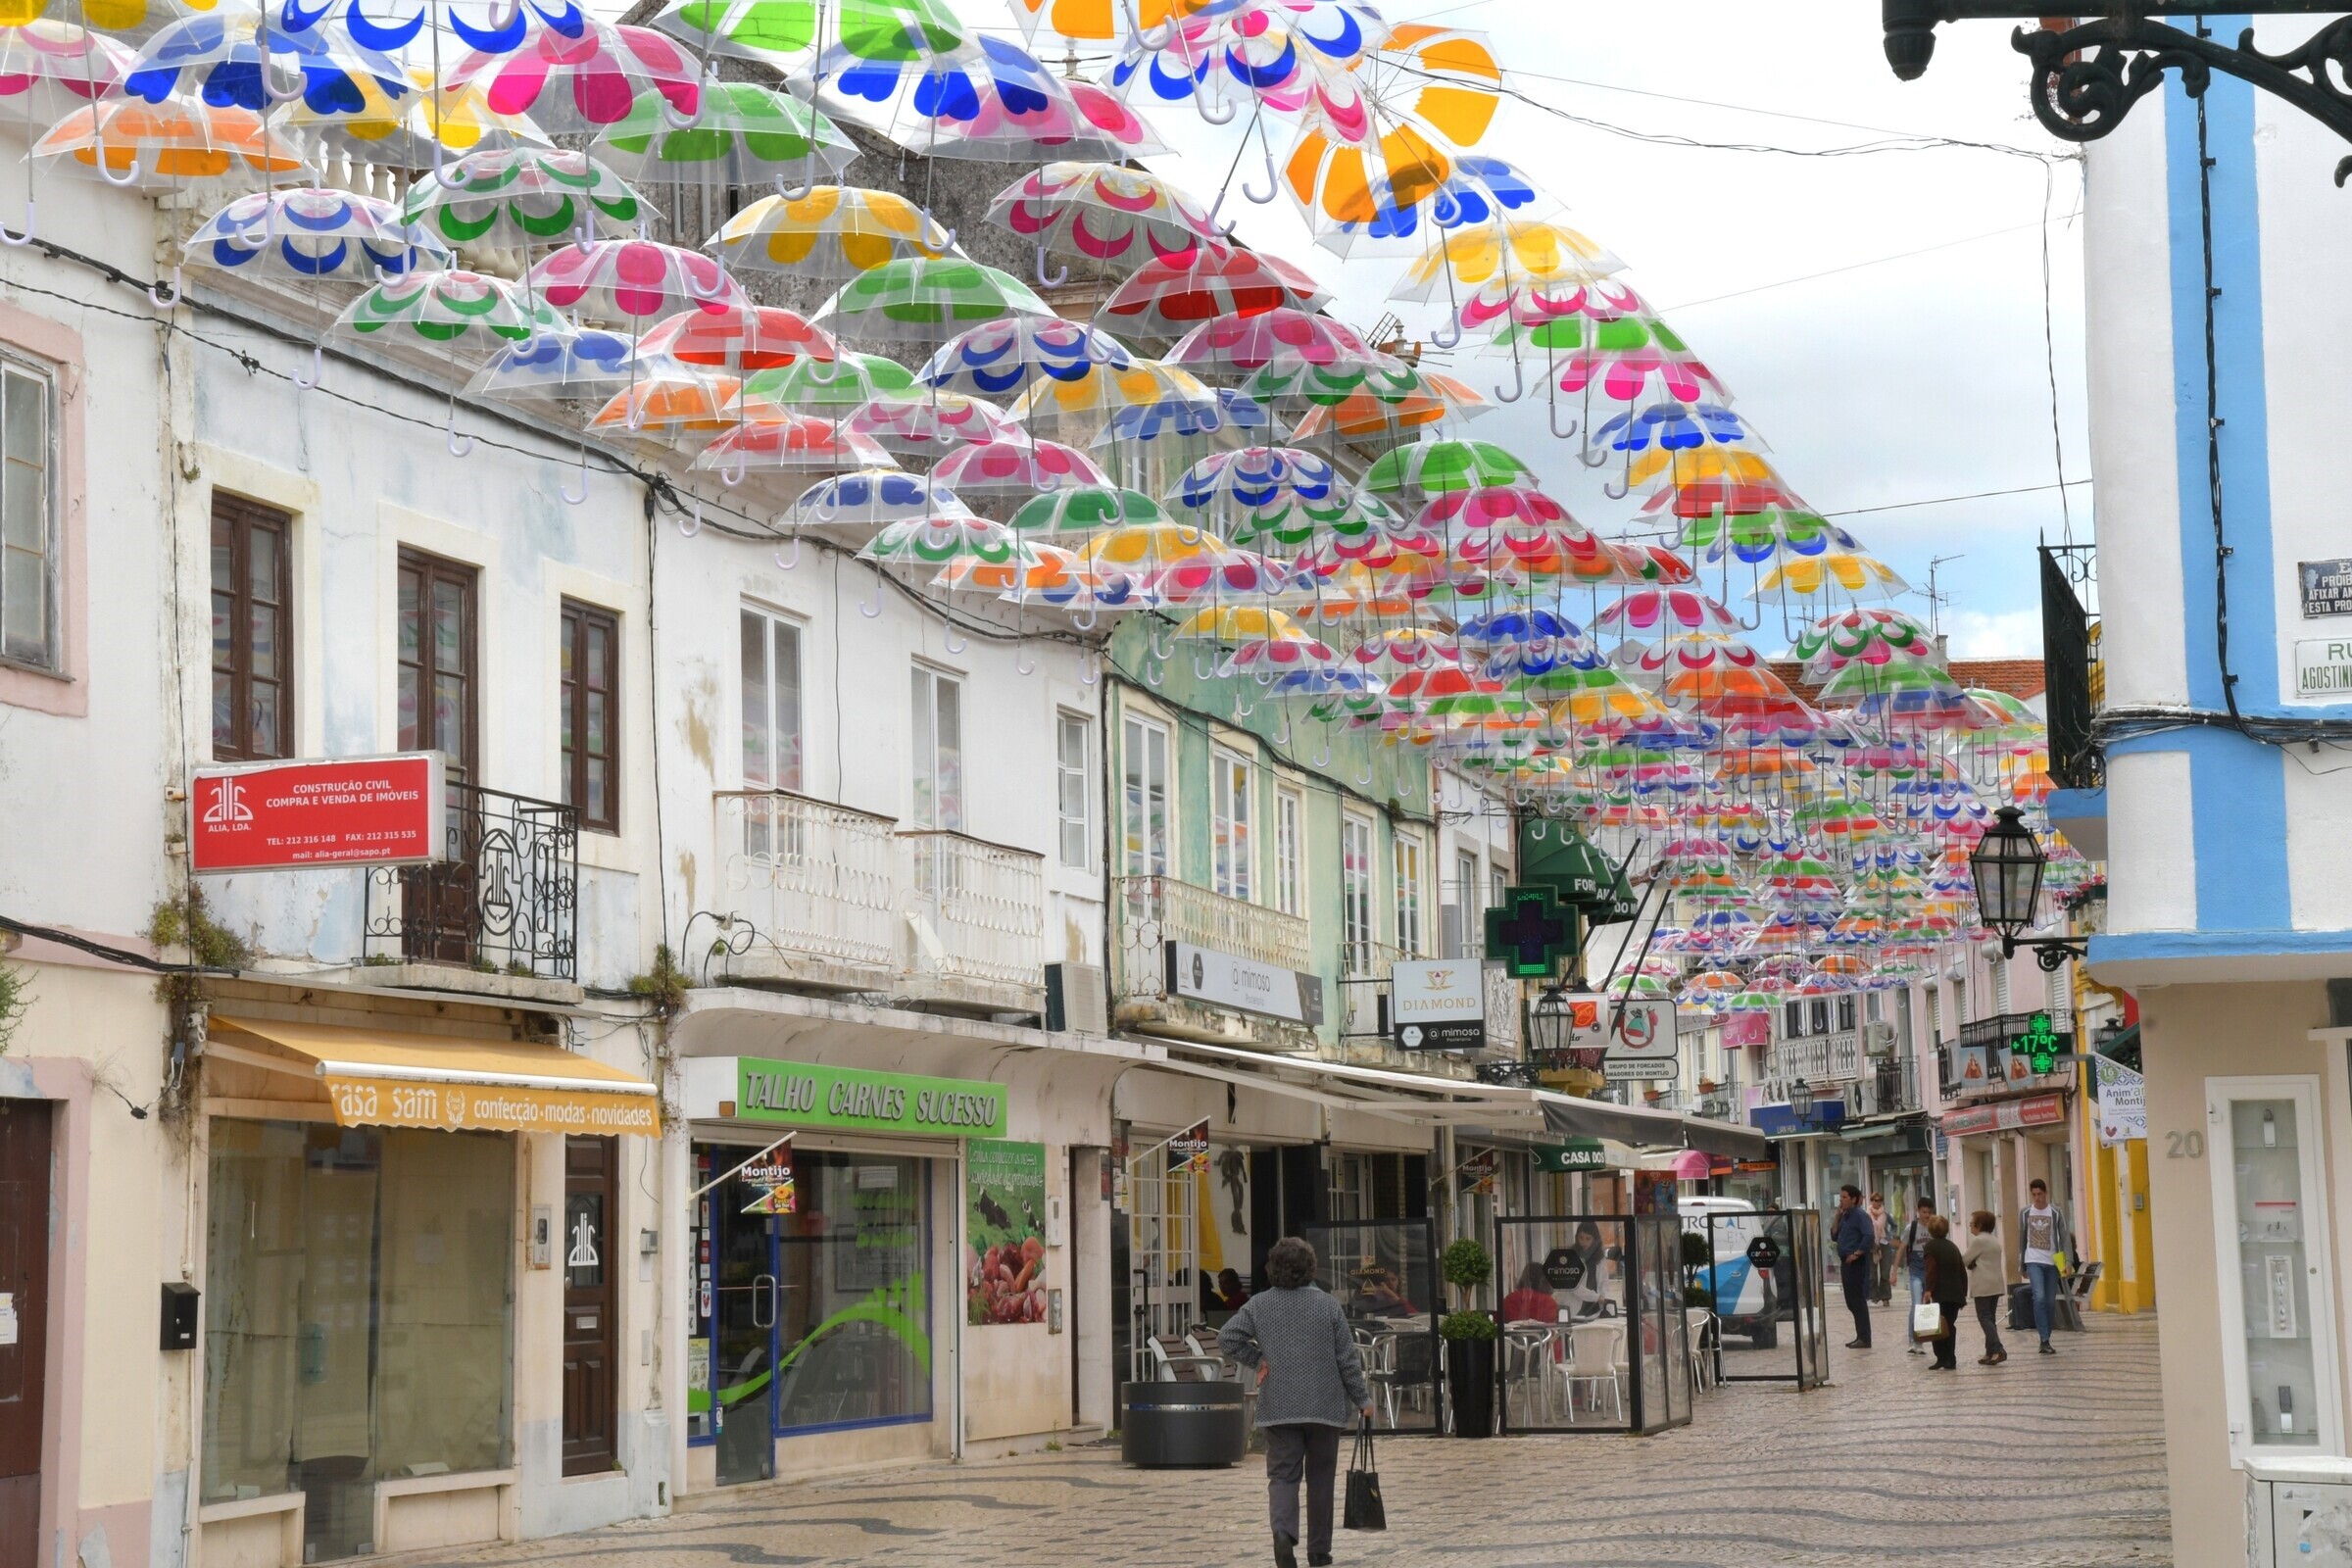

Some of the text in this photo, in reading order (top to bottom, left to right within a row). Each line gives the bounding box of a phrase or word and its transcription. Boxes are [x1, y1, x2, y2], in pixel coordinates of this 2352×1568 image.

[2309, 588, 2339, 601] AFIXAR
[293, 780, 392, 794] CONSTRUÇÃO CIVIL
[267, 790, 418, 808] COMPRA E VENDA DE IMÓVEIS
[208, 823, 252, 833] ALIA, LDA.
[267, 837, 284, 846] TEL:
[321, 835, 336, 844] 148
[345, 833, 365, 842] FAX:
[367, 832, 381, 841] 212
[384, 831, 399, 840] 315
[401, 830, 416, 839] 535
[292, 847, 391, 859] mail: alia-geral@sapo.pt
[1574, 878, 1596, 892] FOR
[1242, 966, 1271, 992] mimosa
[1402, 998, 1477, 1011] DIAMOND
[1441, 1028, 1481, 1037] mimosa
[2103, 1068, 2115, 1077] 16
[392, 1086, 438, 1120] sam
[746, 1071, 999, 1128] TALHO CARNES SUCESSO
[473, 1097, 654, 1127] confecção modas novidades
[1169, 1139, 1207, 1149] Montijo
[2165, 1130, 2205, 1159] 20
[1561, 1152, 1605, 1164] CASA DOS
[741, 1165, 791, 1177] Montijo
